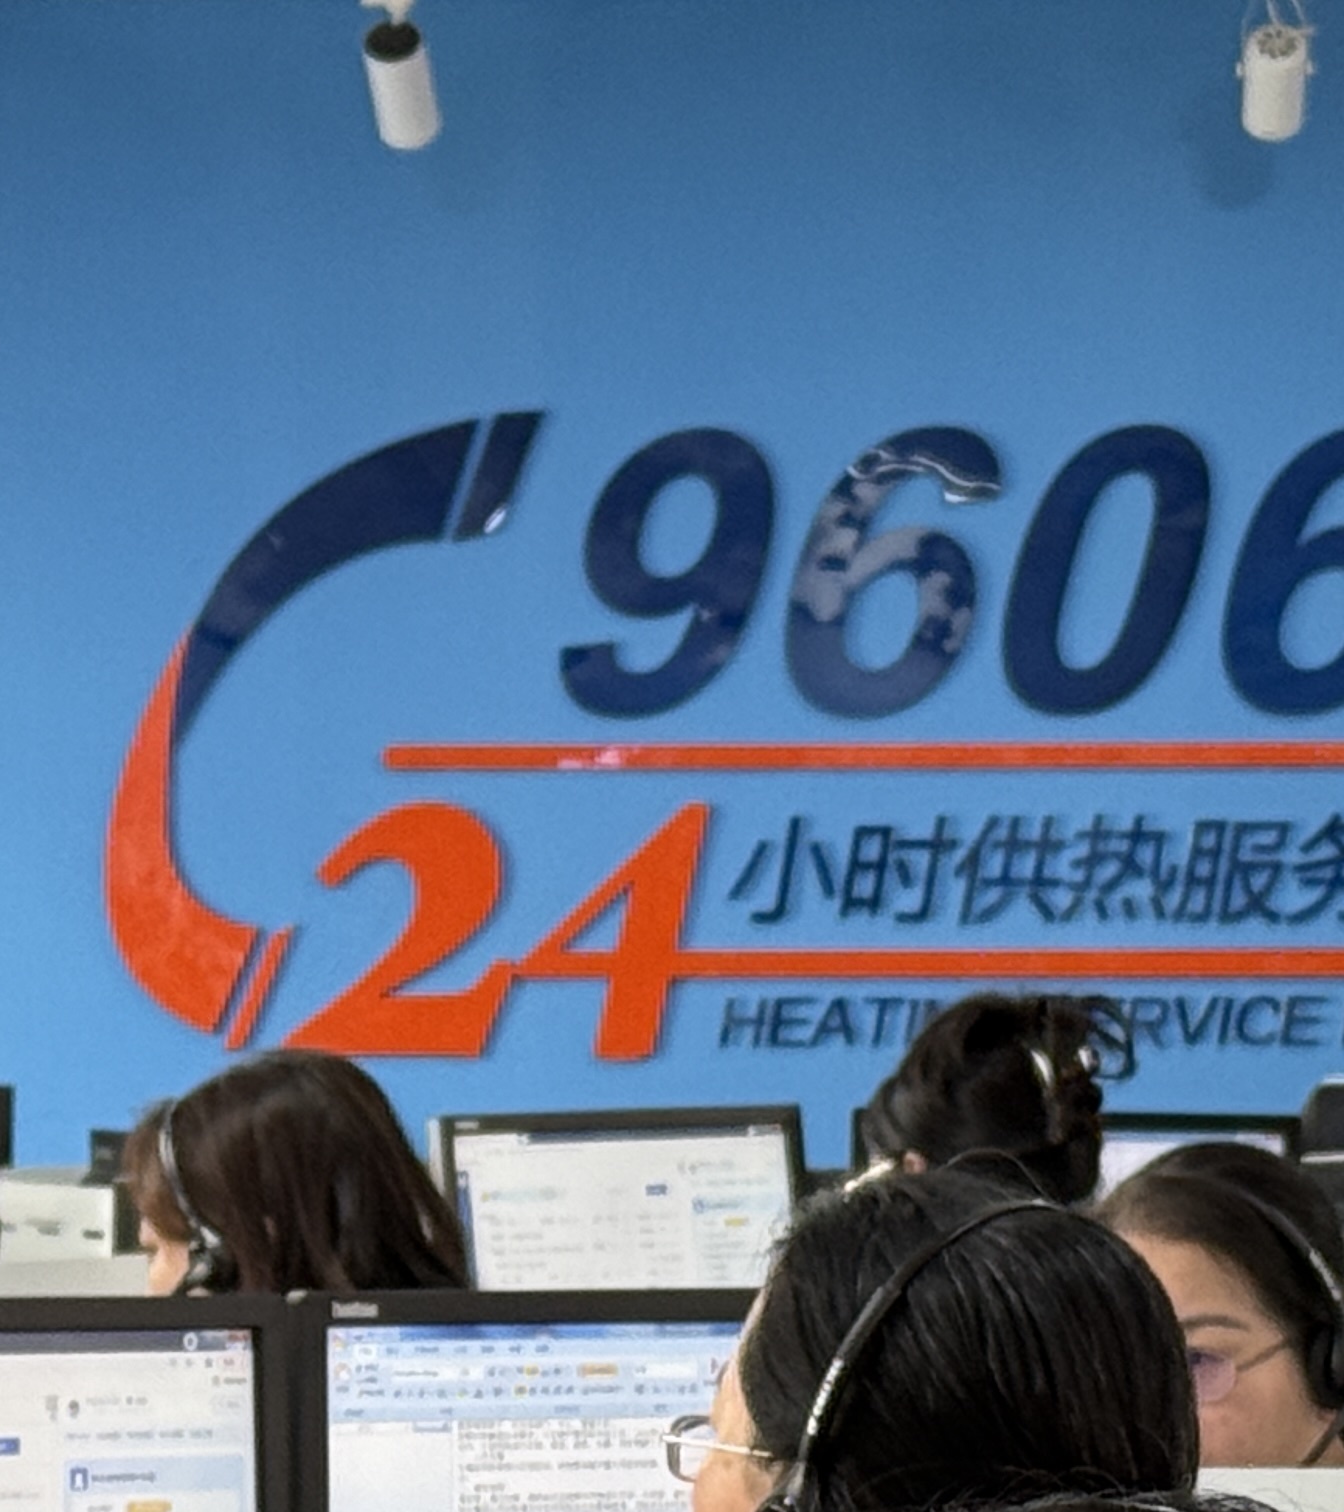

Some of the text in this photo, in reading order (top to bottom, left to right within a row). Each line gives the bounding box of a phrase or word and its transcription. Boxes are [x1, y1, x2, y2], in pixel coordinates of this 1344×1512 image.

[280, 798, 711, 1061] 24
[719, 996, 940, 1048] HEATI
[1118, 994, 1330, 1048] RVICE
